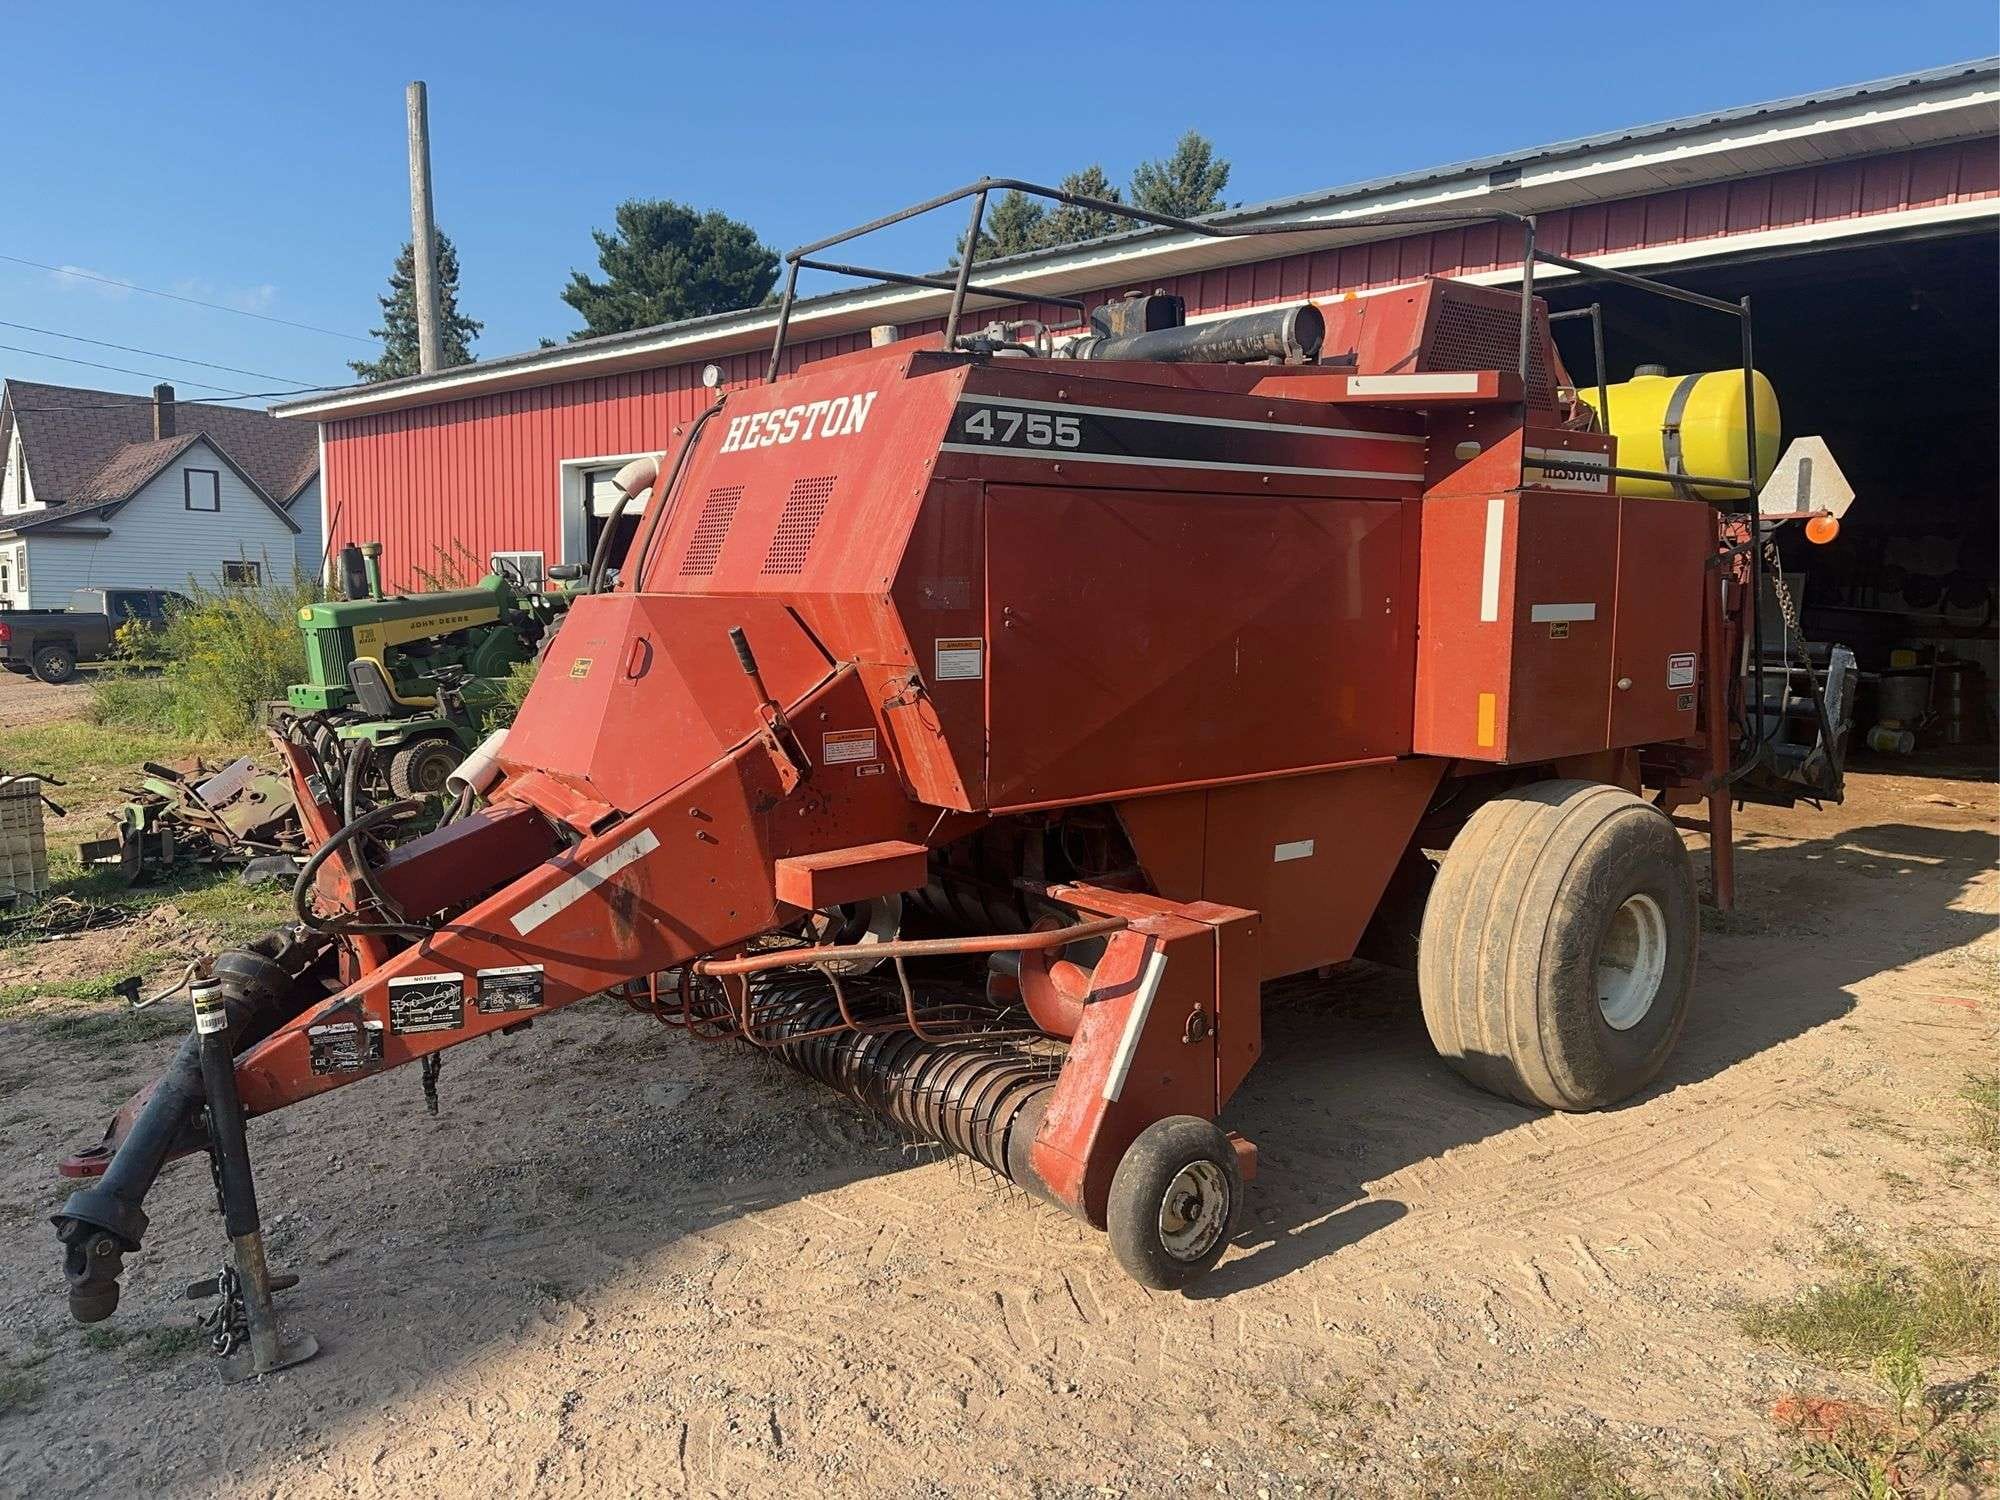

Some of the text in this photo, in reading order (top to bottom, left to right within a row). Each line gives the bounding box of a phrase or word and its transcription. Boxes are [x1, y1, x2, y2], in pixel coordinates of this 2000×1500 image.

[720, 391, 878, 453] HESSTON
[965, 409, 1081, 447] 4755
[410, 615, 469, 629] JOHN DEERE
